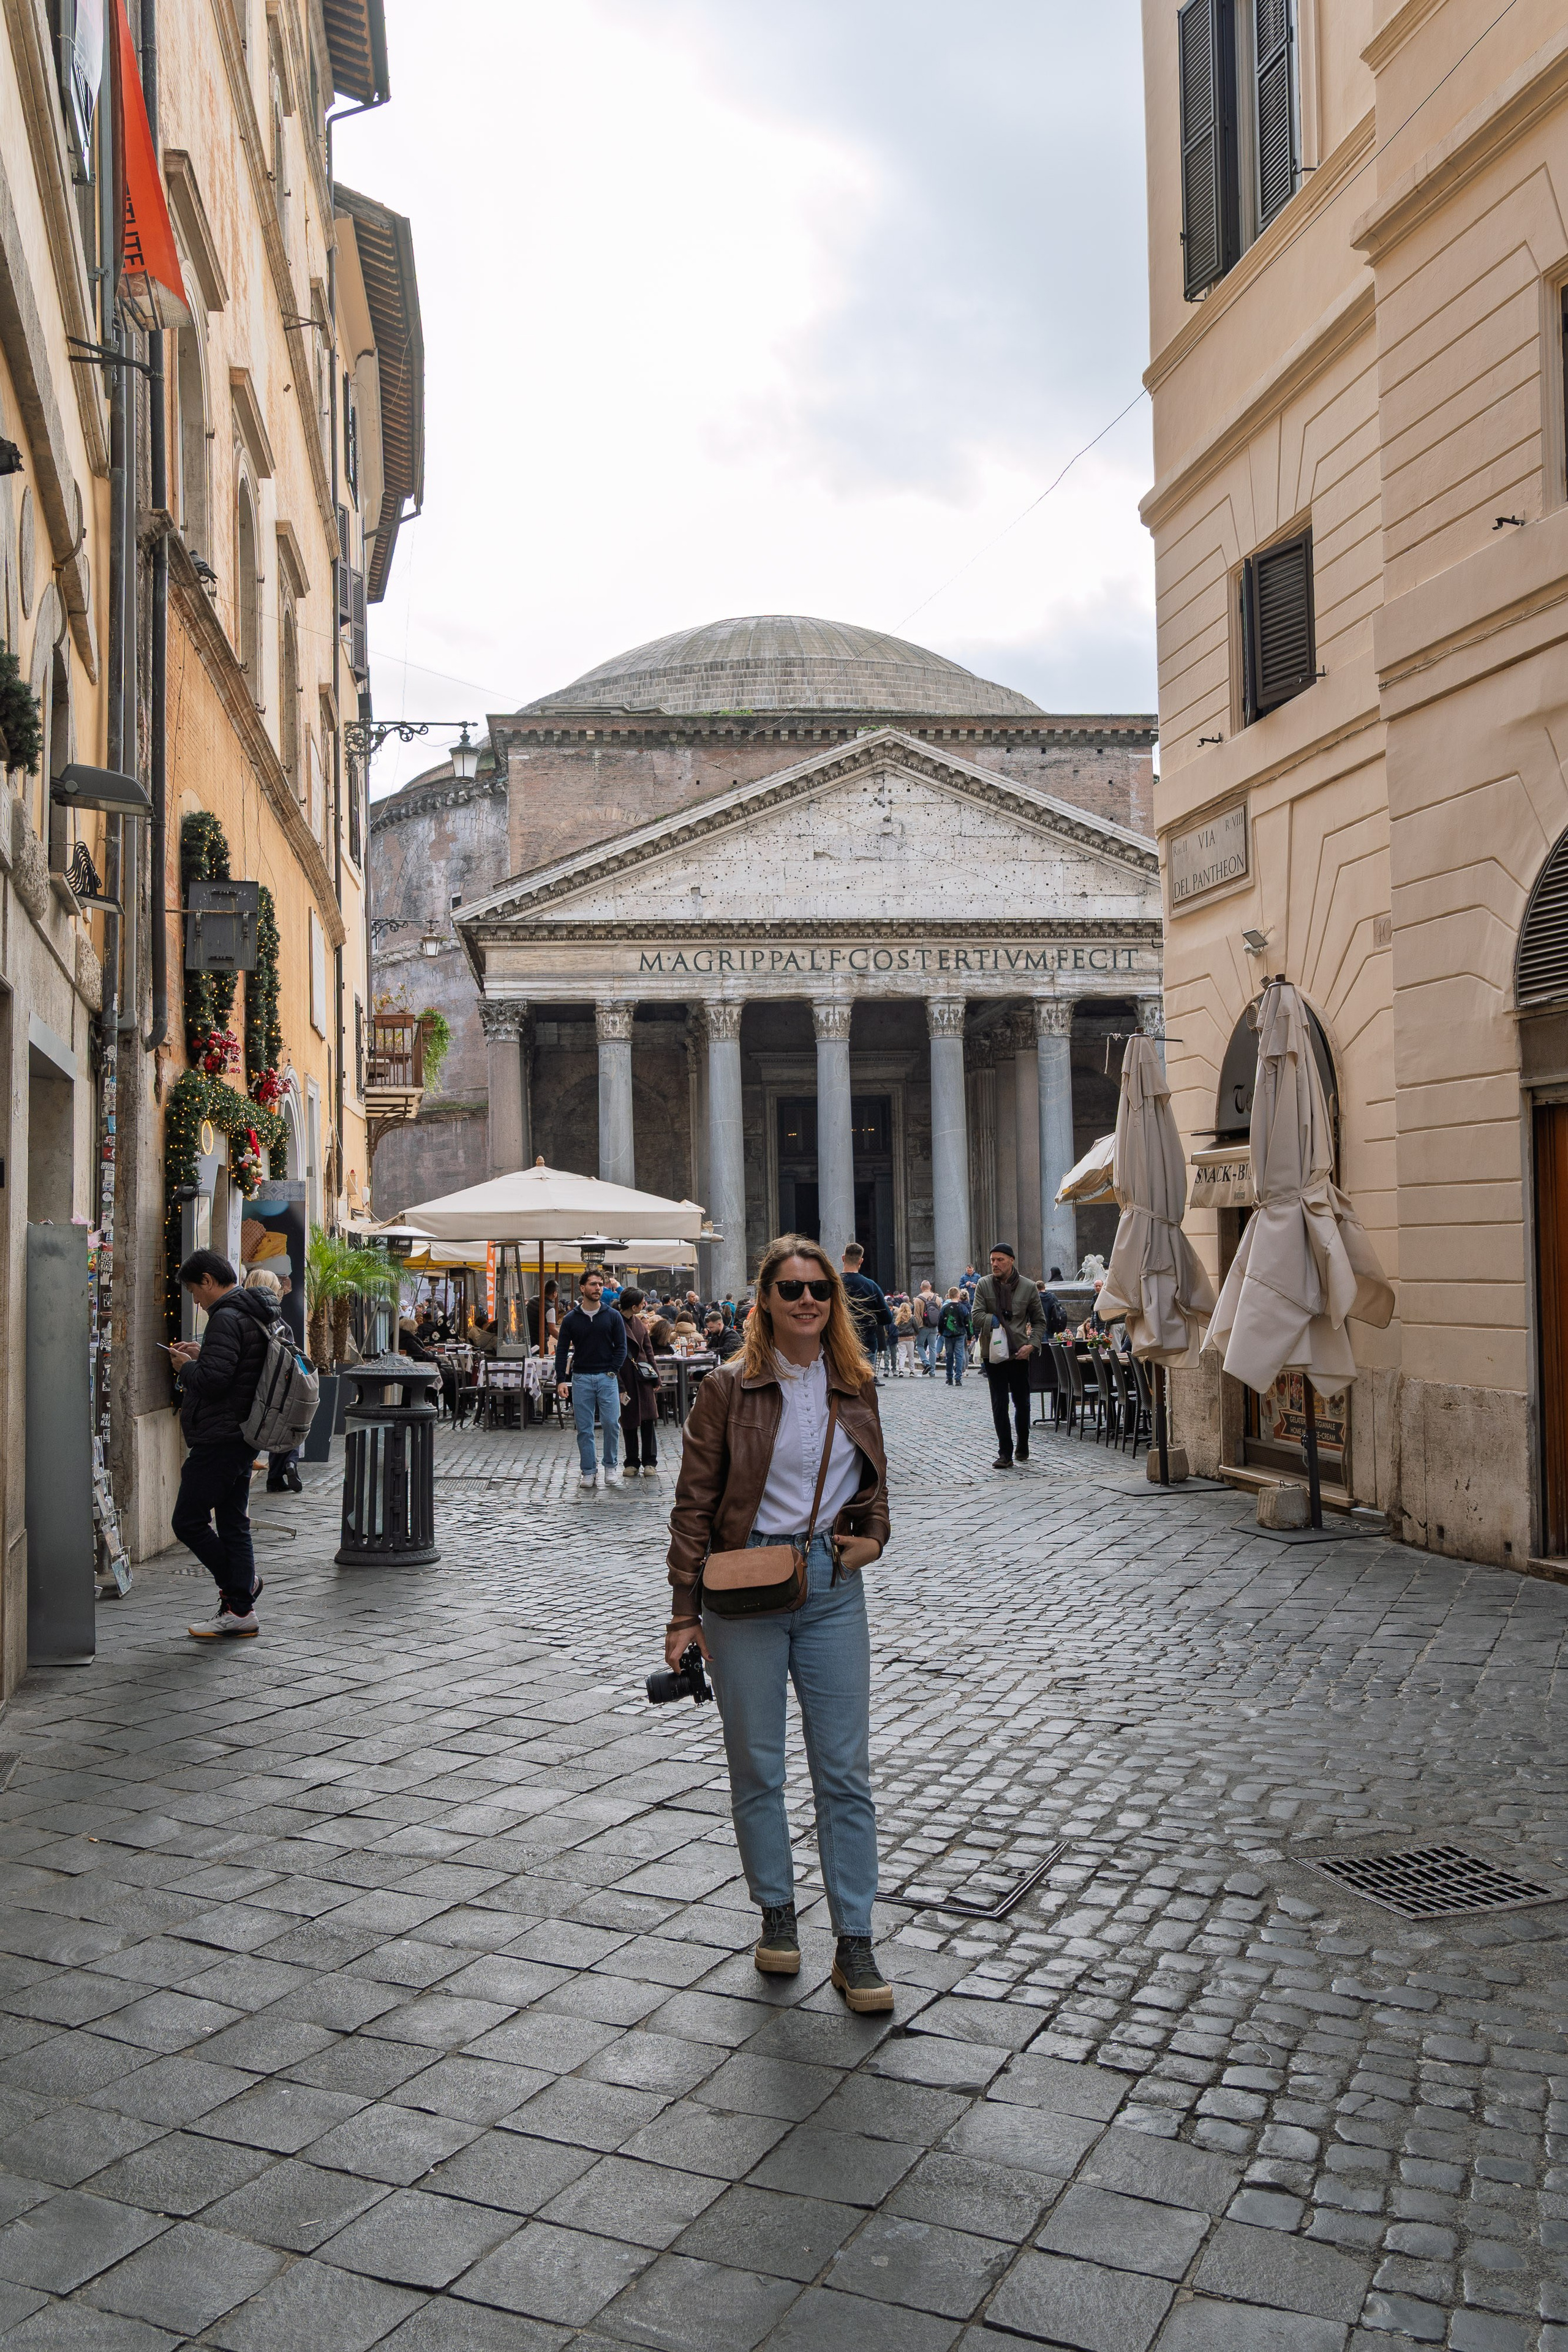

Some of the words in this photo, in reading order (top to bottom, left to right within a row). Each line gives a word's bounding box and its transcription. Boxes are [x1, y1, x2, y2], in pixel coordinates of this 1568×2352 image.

[1198, 829, 1216, 850] VIA
[1174, 878, 1190, 899] DEL
[1193, 852, 1244, 891] PANTHEON
[1233, 1084, 1253, 1114] Te
[1315, 1420, 1336, 1430] TIGIANALE
